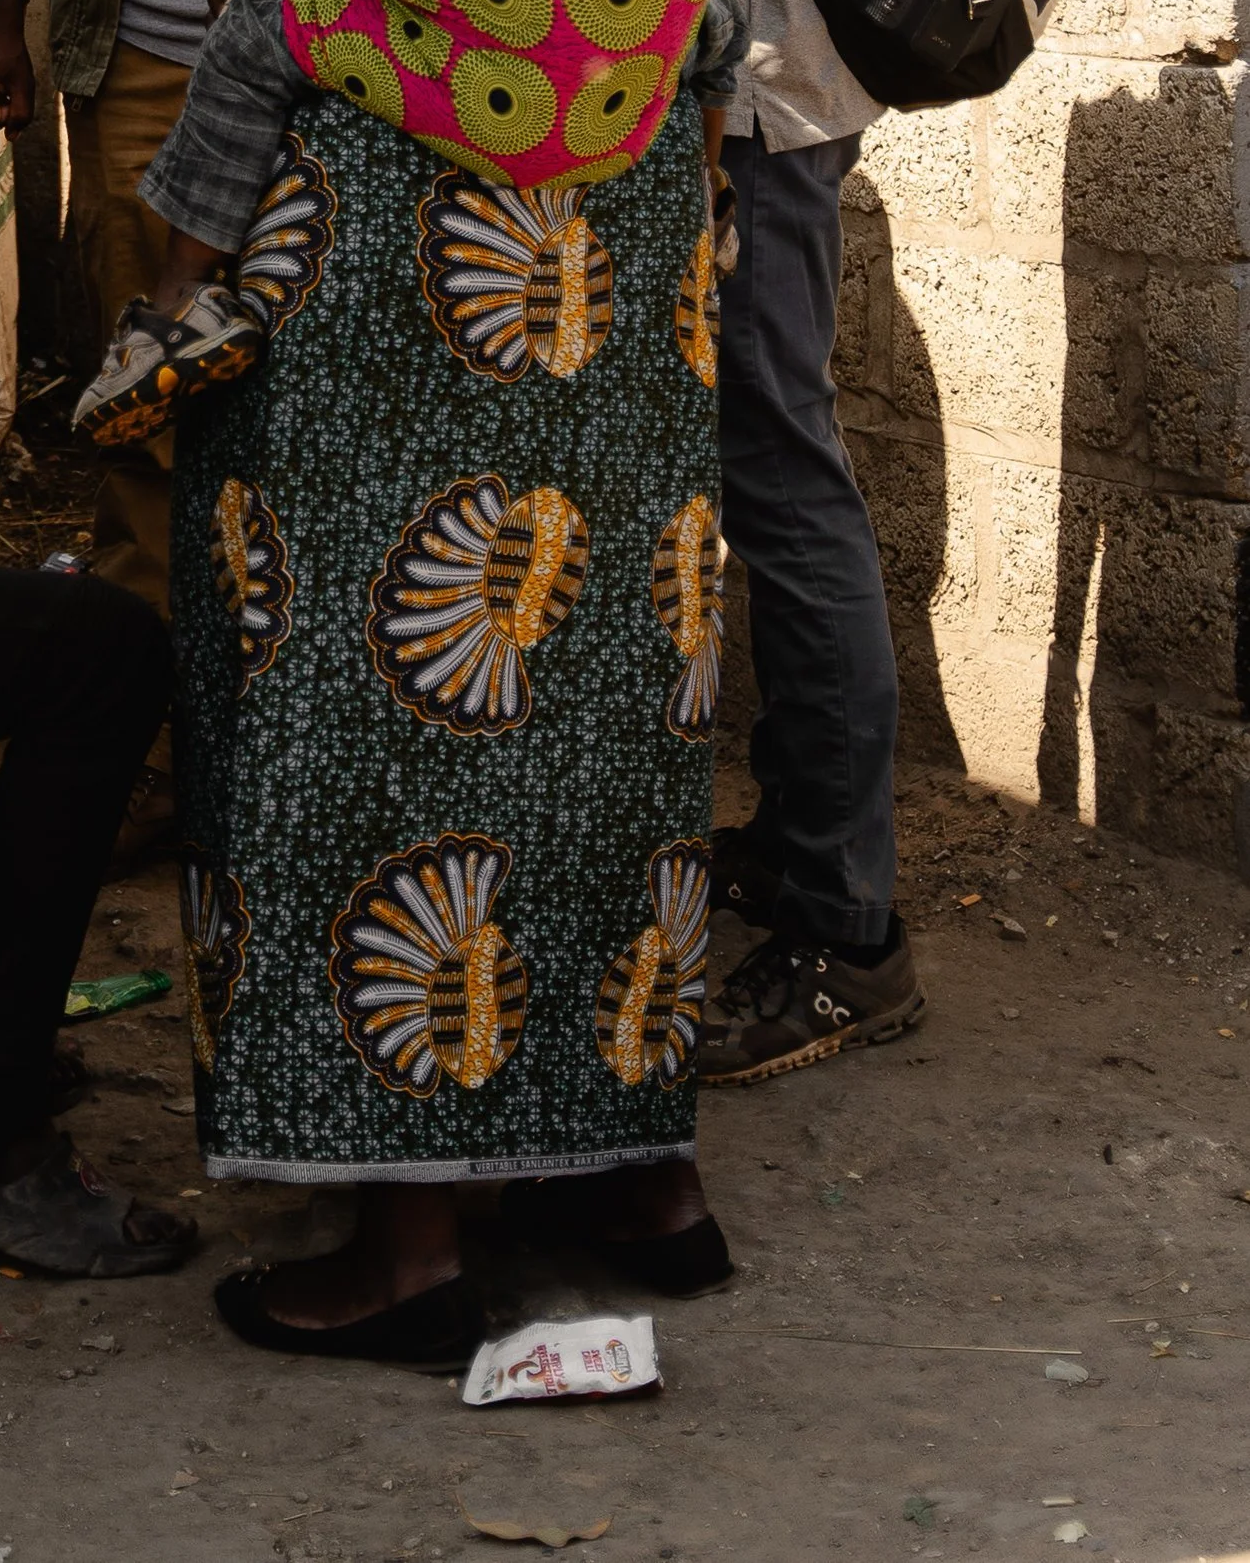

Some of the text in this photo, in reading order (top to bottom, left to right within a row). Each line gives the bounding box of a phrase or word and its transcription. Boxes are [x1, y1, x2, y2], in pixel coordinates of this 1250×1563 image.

[475, 1160, 517, 1172] VERITABLE
[573, 1156, 592, 1166] WAX
[594, 1153, 619, 1165] BLOCK
[621, 1150, 648, 1161] PRINTS
